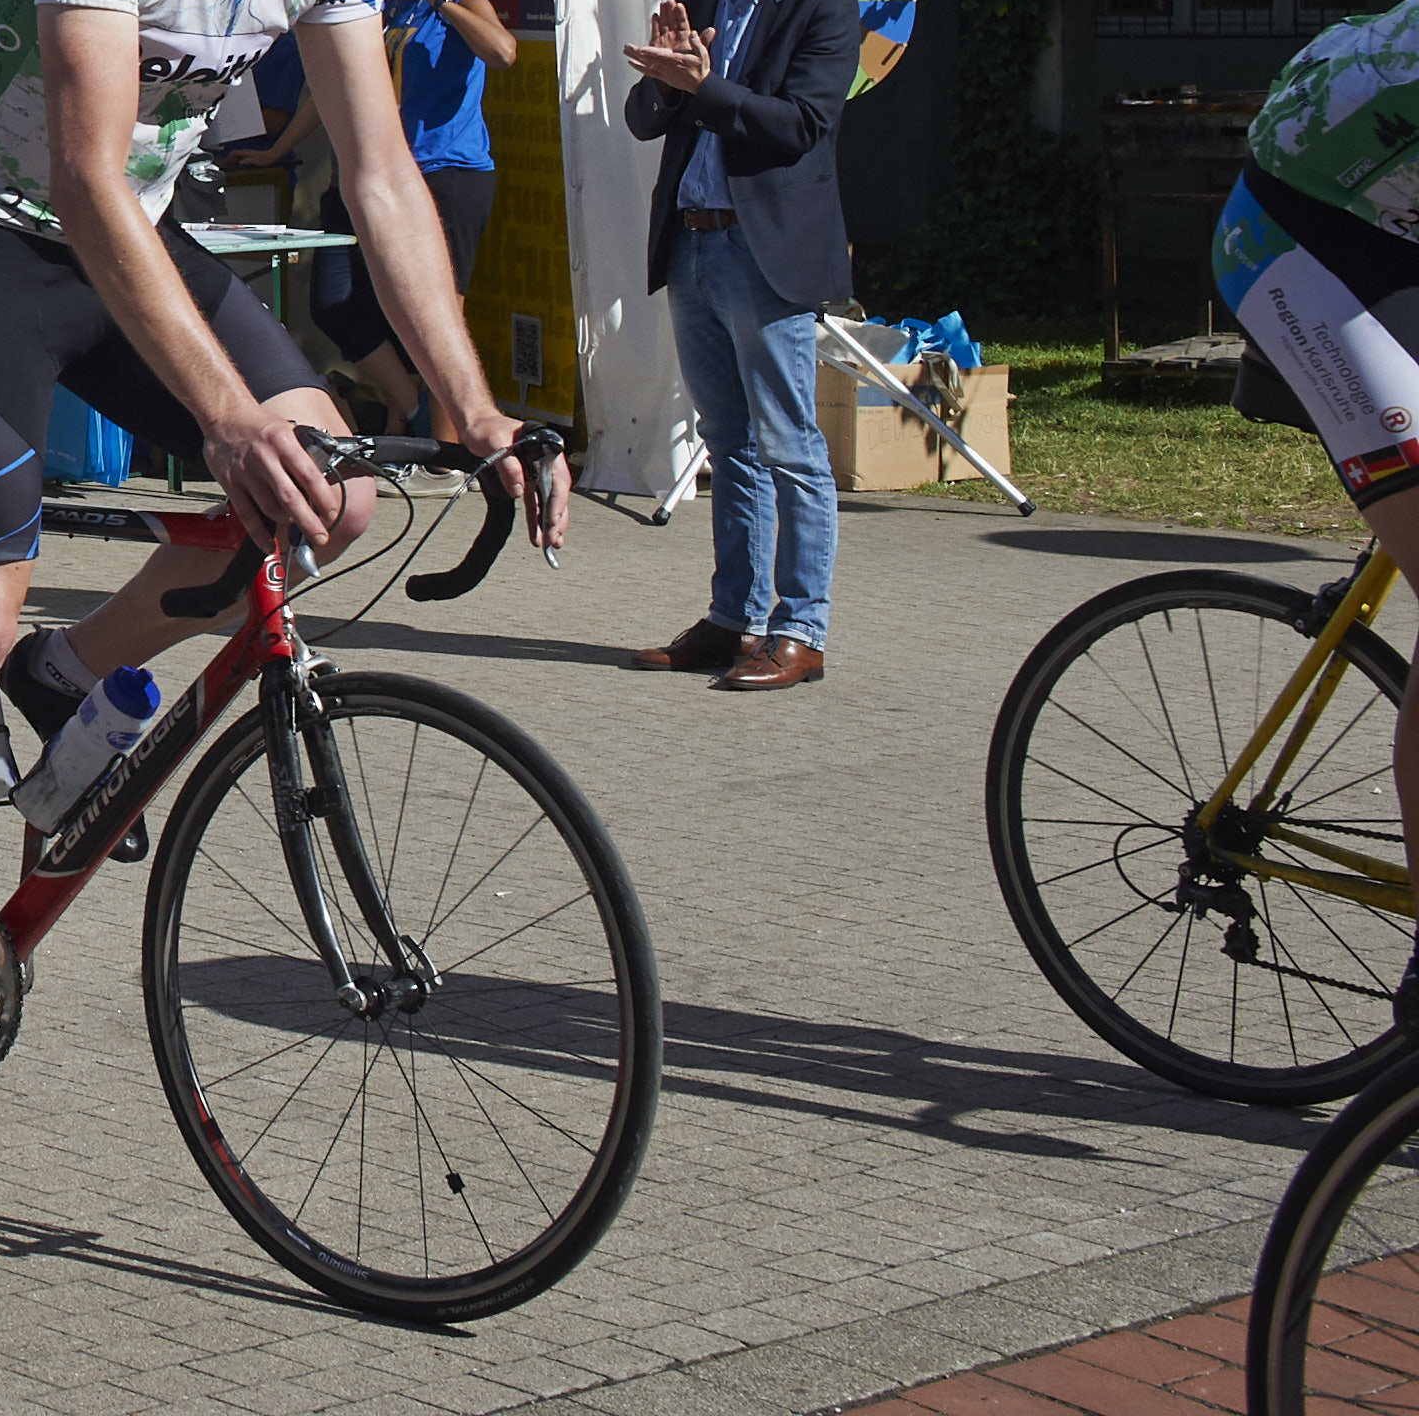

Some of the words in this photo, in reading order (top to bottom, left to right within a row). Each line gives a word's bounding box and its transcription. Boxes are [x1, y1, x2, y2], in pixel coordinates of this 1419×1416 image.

[140, 49, 264, 85] eloitt
[1268, 286, 1308, 348] Region
[1305, 346, 1357, 423] Karlsruhe
[1311, 321, 1376, 416] Technologie
[50, 692, 193, 866] cannondale
